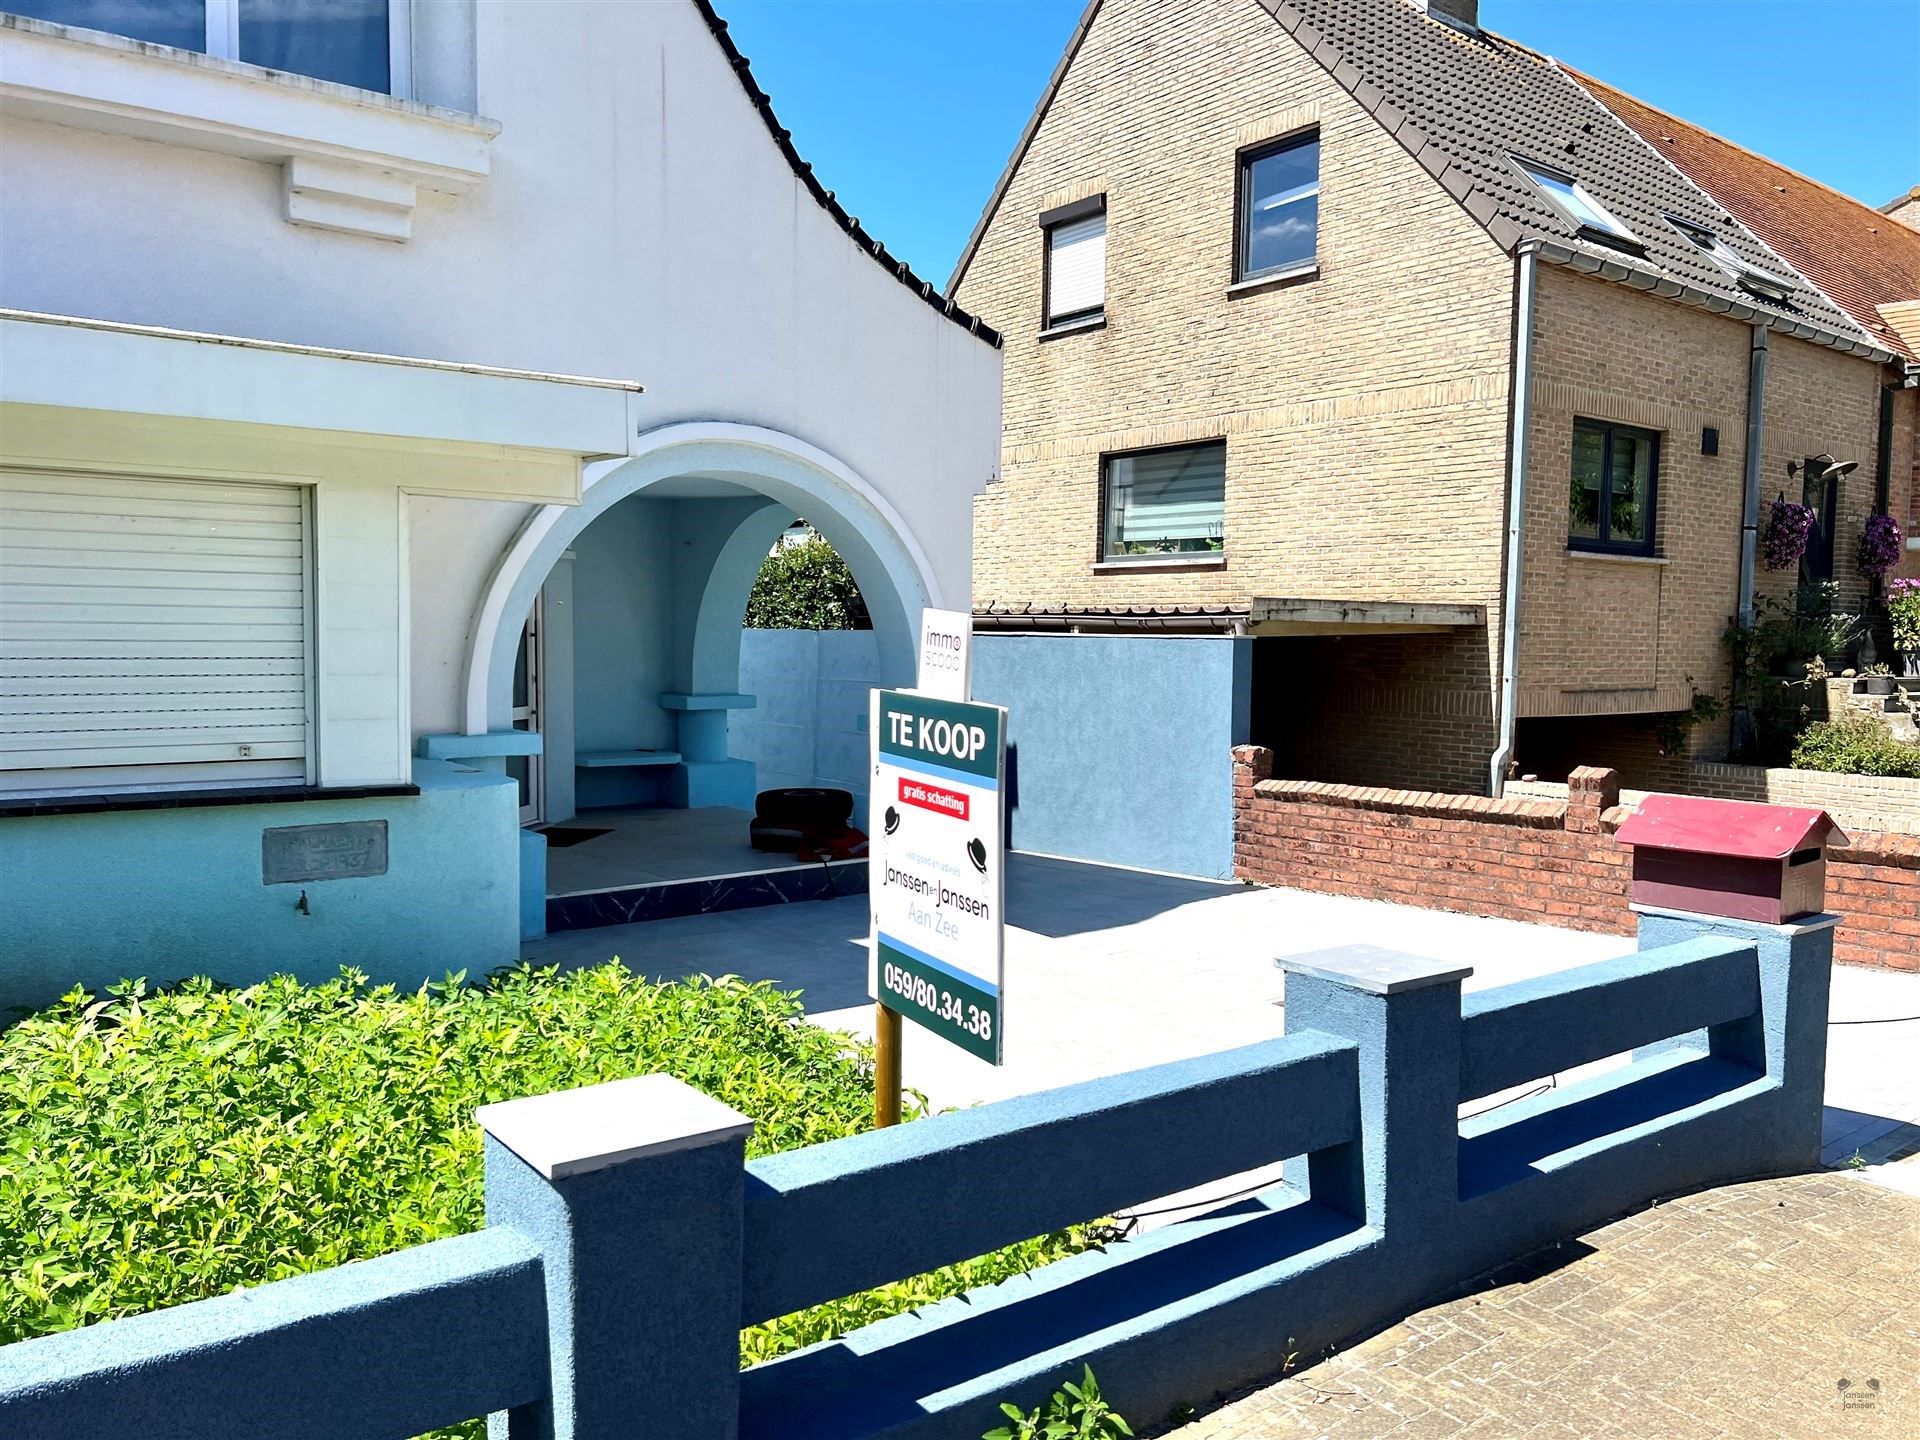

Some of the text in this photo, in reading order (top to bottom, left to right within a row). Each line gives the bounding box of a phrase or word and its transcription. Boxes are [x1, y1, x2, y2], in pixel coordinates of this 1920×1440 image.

[926, 626, 962, 651] immo
[888, 711, 986, 761] TE KOOP
[903, 785, 965, 815] gratis schatting
[883, 860, 930, 897] Janssen
[935, 879, 990, 920] Janssen
[908, 901, 960, 941] Aan Zee
[884, 962, 992, 1041] 059/80.34.38
